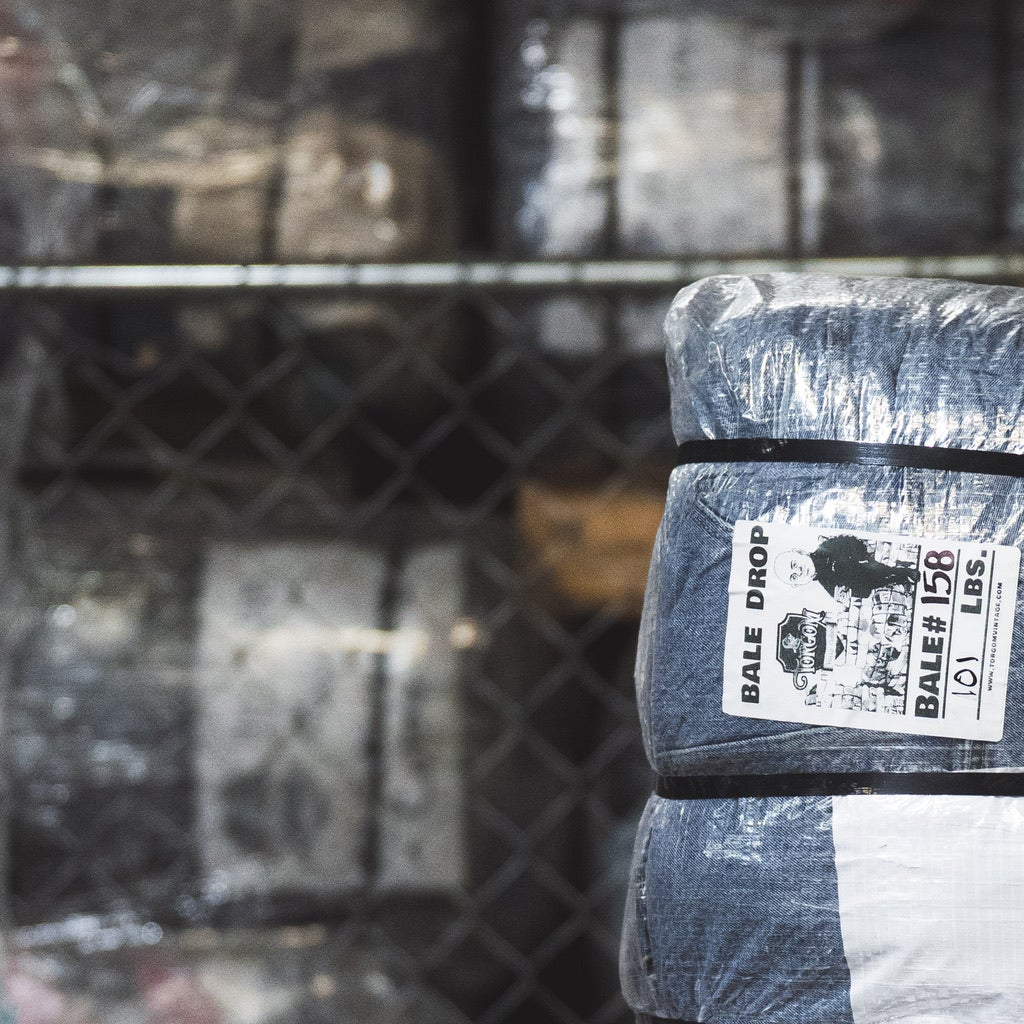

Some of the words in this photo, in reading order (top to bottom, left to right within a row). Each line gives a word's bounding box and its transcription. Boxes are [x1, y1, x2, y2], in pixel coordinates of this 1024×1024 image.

[746, 525, 769, 610] DROP
[921, 549, 956, 605] 158
[960, 549, 988, 615] LBS.
[741, 626, 763, 704] BALE
[914, 614, 947, 719] BALE#
[951, 656, 979, 697] 101
